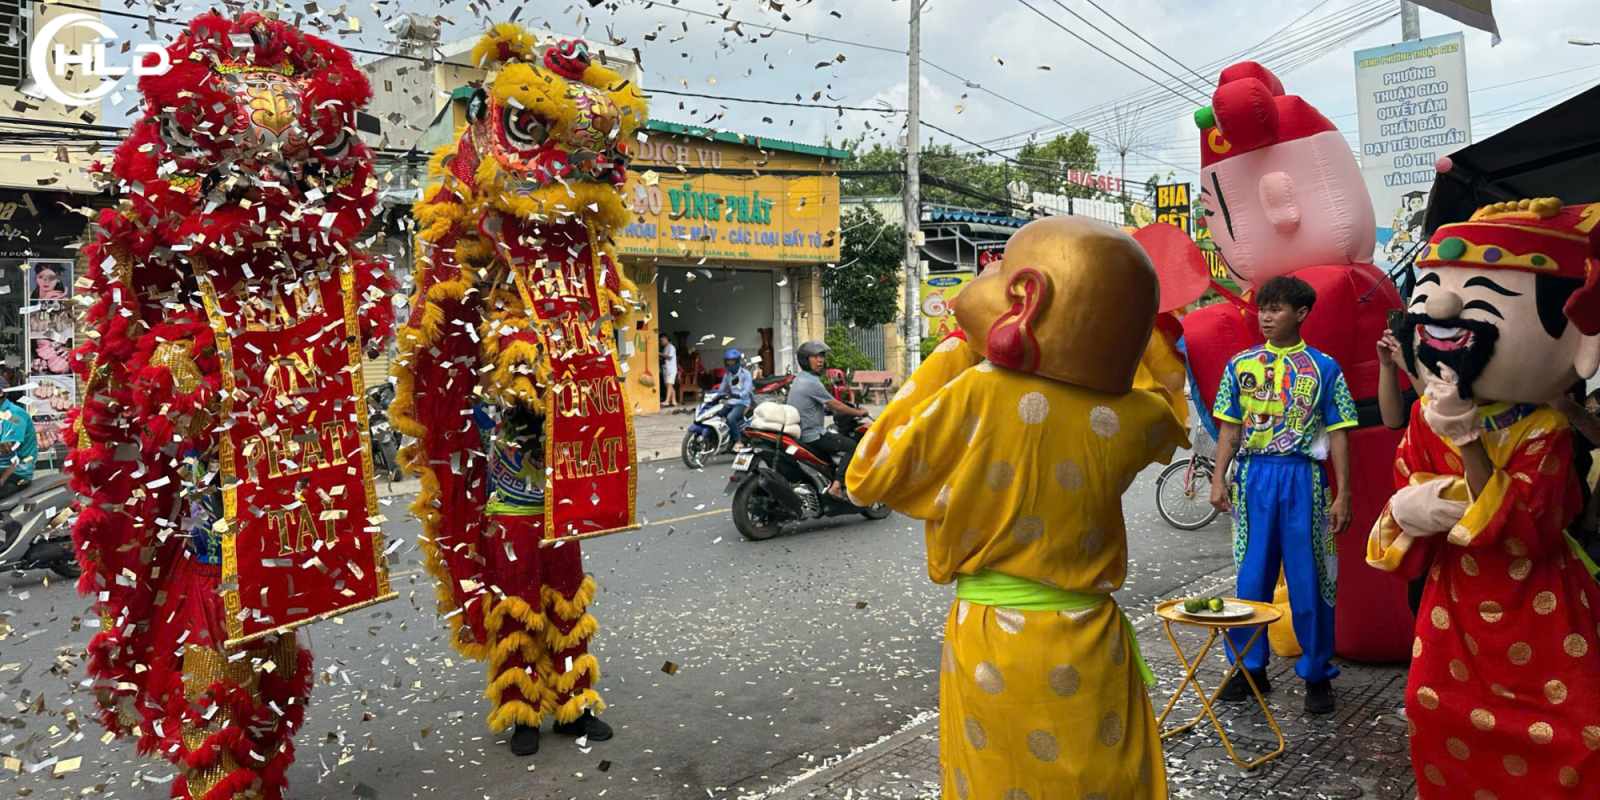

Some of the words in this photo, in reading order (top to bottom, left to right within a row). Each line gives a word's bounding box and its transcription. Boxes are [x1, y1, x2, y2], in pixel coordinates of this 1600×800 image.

[1359, 56, 1379, 68] UBND
[1413, 47, 1439, 59] THUẬN
[1440, 43, 1459, 54] GIAO
[1383, 66, 1436, 85] PHƯỜNG
[1374, 85, 1415, 103] THUẬN
[1417, 81, 1448, 97] GIAO
[1377, 101, 1416, 121] QUYẾT
[1418, 98, 1447, 113] TÂM
[1381, 118, 1416, 136] PHẤN
[1417, 113, 1445, 131] ĐẤU
[638, 141, 691, 166] DỊCH
[1364, 142, 1389, 156] ĐẠT
[1391, 136, 1418, 152] TIÊU
[1420, 128, 1466, 148] CHUẨN
[1394, 153, 1414, 168] ĐÔ
[1414, 152, 1436, 167] THỊ
[1067, 169, 1095, 188] BIA
[1384, 171, 1411, 187] VĂN
[1412, 170, 1437, 184] MIN
[668, 182, 722, 221] VĨNH
[726, 190, 773, 225] PHÁT
[1158, 184, 1188, 208] BIA
[618, 222, 657, 242] HOẠI
[670, 224, 687, 240] XE
[728, 226, 752, 245] CÁC
[754, 230, 779, 249] LOẠI
[782, 228, 806, 247] GIẤY
[515, 261, 590, 300] KHAI
[262, 346, 319, 403] ĂN
[555, 427, 623, 480] PHÁT
